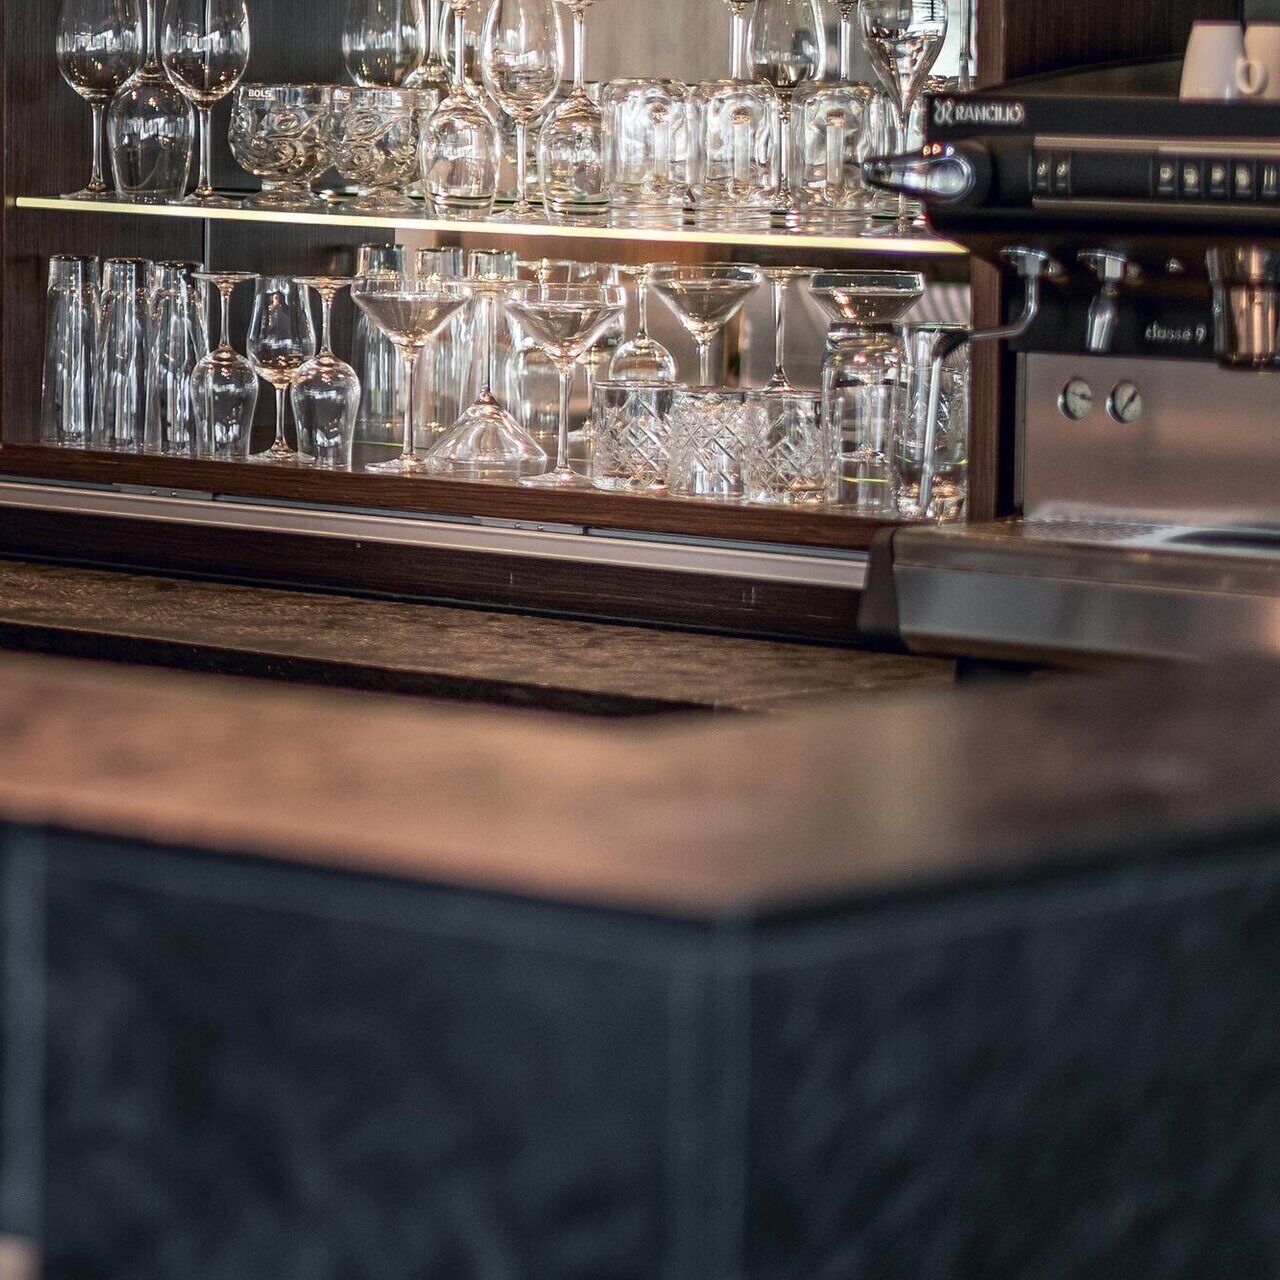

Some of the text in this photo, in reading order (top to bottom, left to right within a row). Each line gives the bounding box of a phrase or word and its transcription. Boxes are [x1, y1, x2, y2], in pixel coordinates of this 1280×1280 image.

[955, 103, 1024, 122] RANCILIO
[1145, 320, 1207, 343] classe 9
